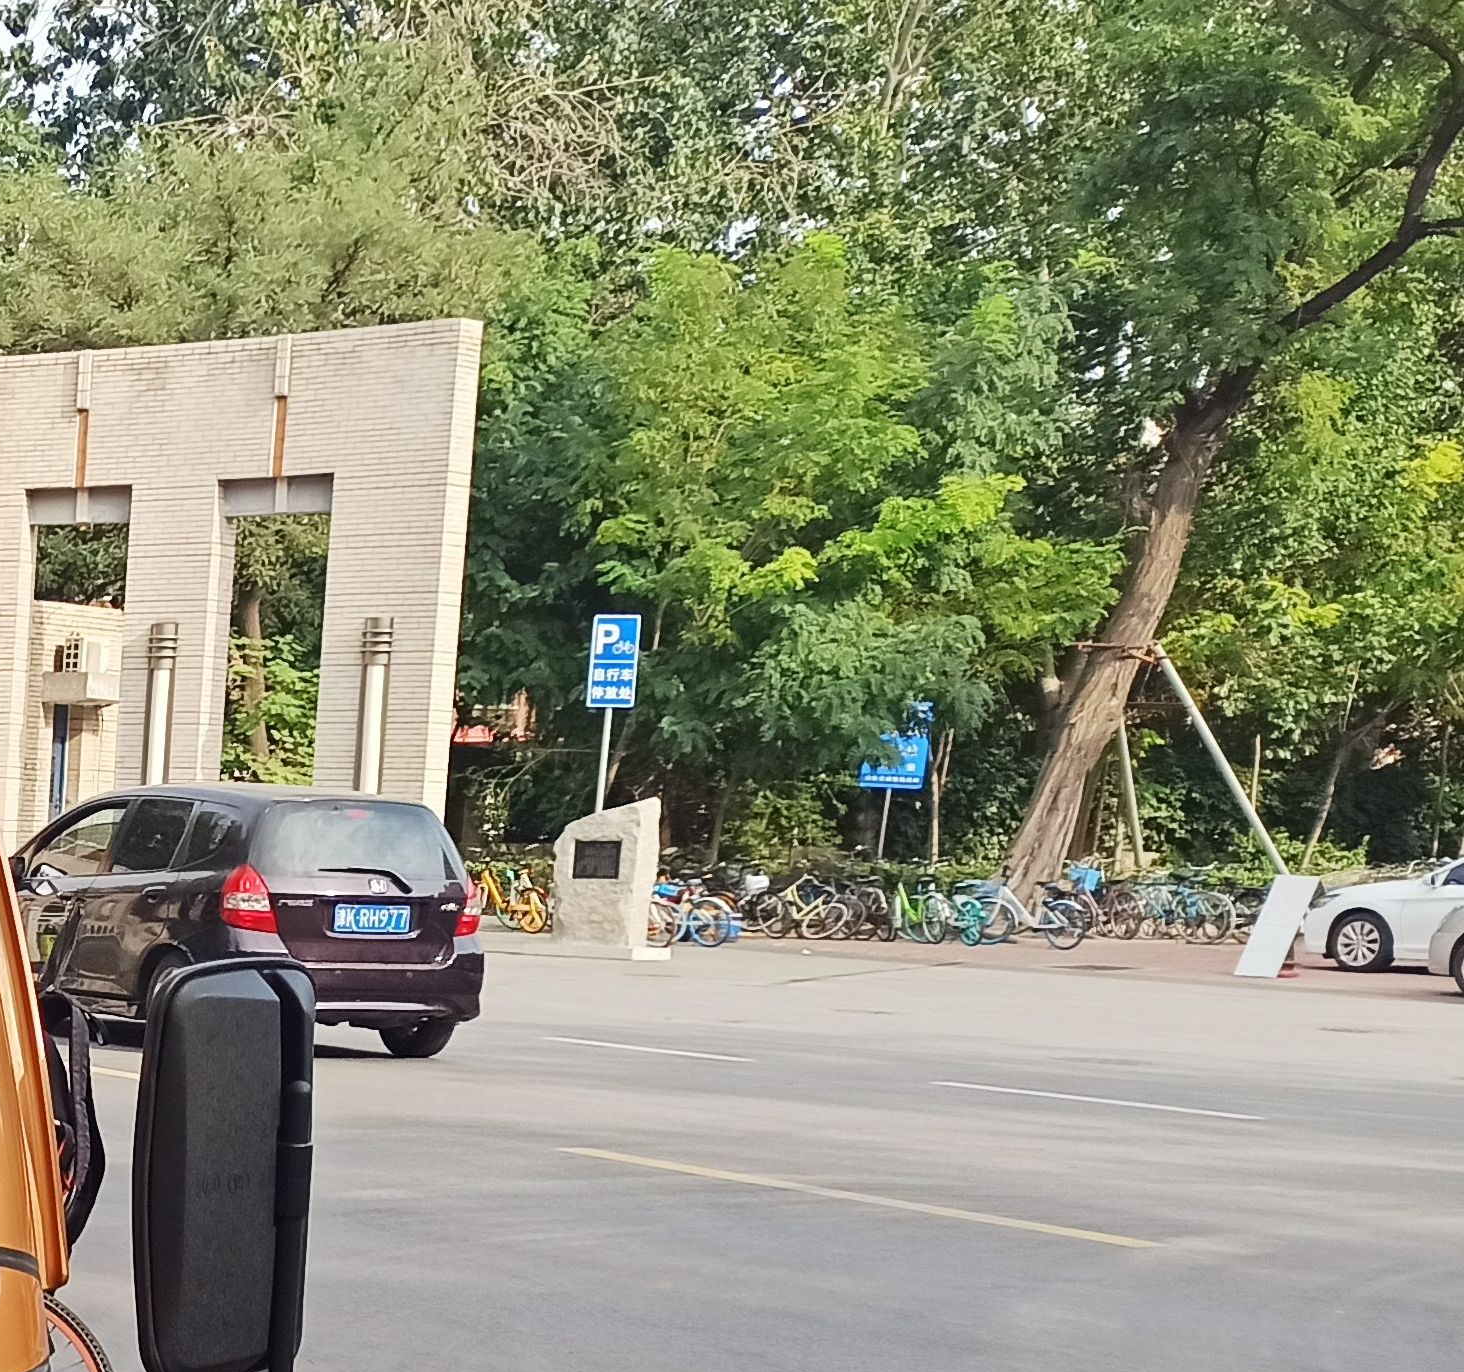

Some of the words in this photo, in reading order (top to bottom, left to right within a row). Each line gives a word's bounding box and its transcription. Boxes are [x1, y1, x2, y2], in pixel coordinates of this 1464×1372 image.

[595, 623, 620, 655] P
[593, 667, 634, 682] 自行车
